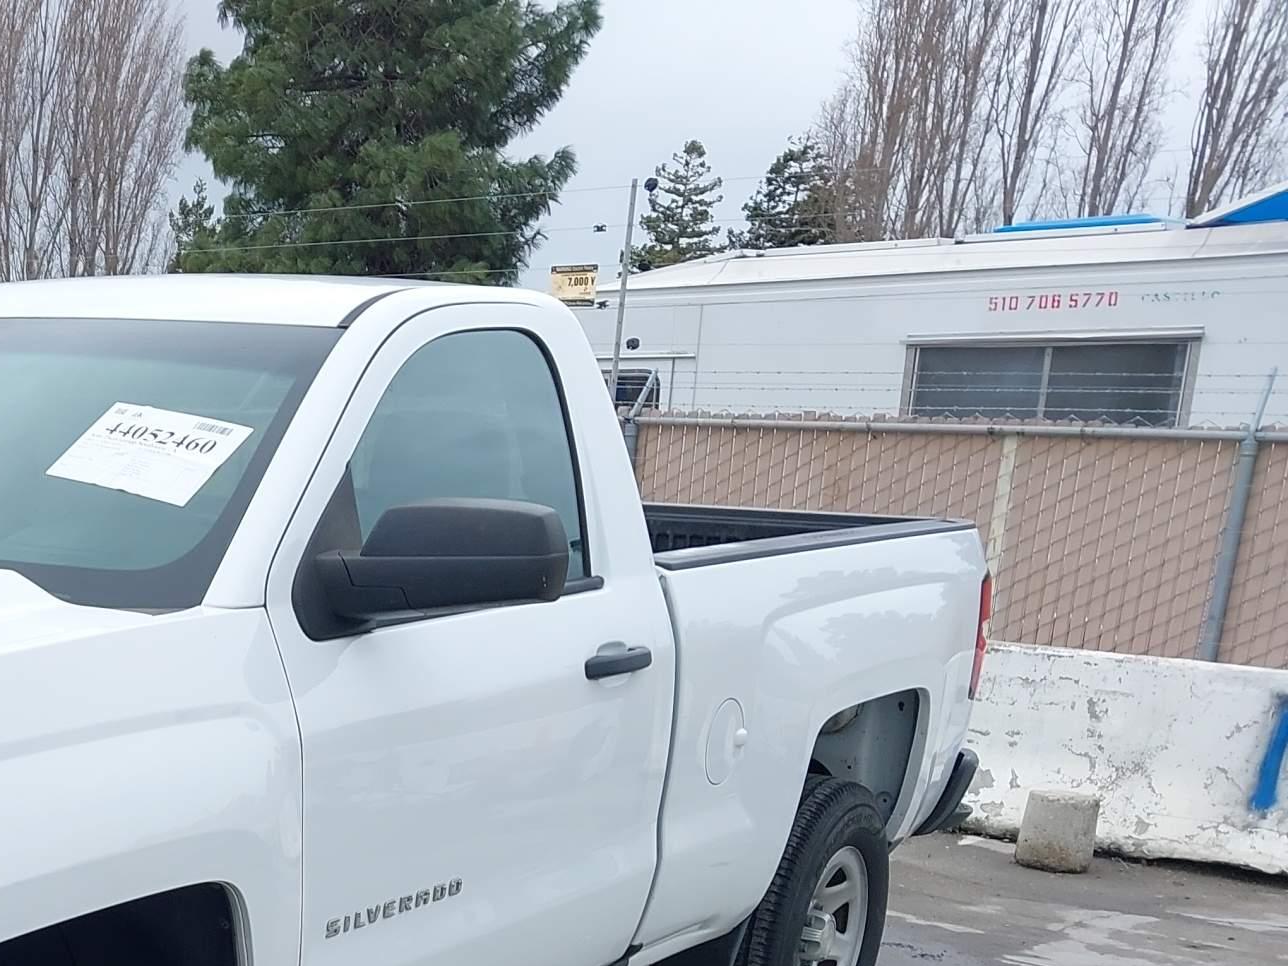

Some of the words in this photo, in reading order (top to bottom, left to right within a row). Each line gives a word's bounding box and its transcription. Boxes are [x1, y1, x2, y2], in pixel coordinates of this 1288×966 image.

[567, 277, 589, 288] 7,000
[988, 296, 1019, 312] 510
[1025, 294, 1061, 310] 706
[1068, 291, 1119, 308] 5770
[104, 422, 218, 455] 44052460
[325, 878, 463, 939] SILVERADO
